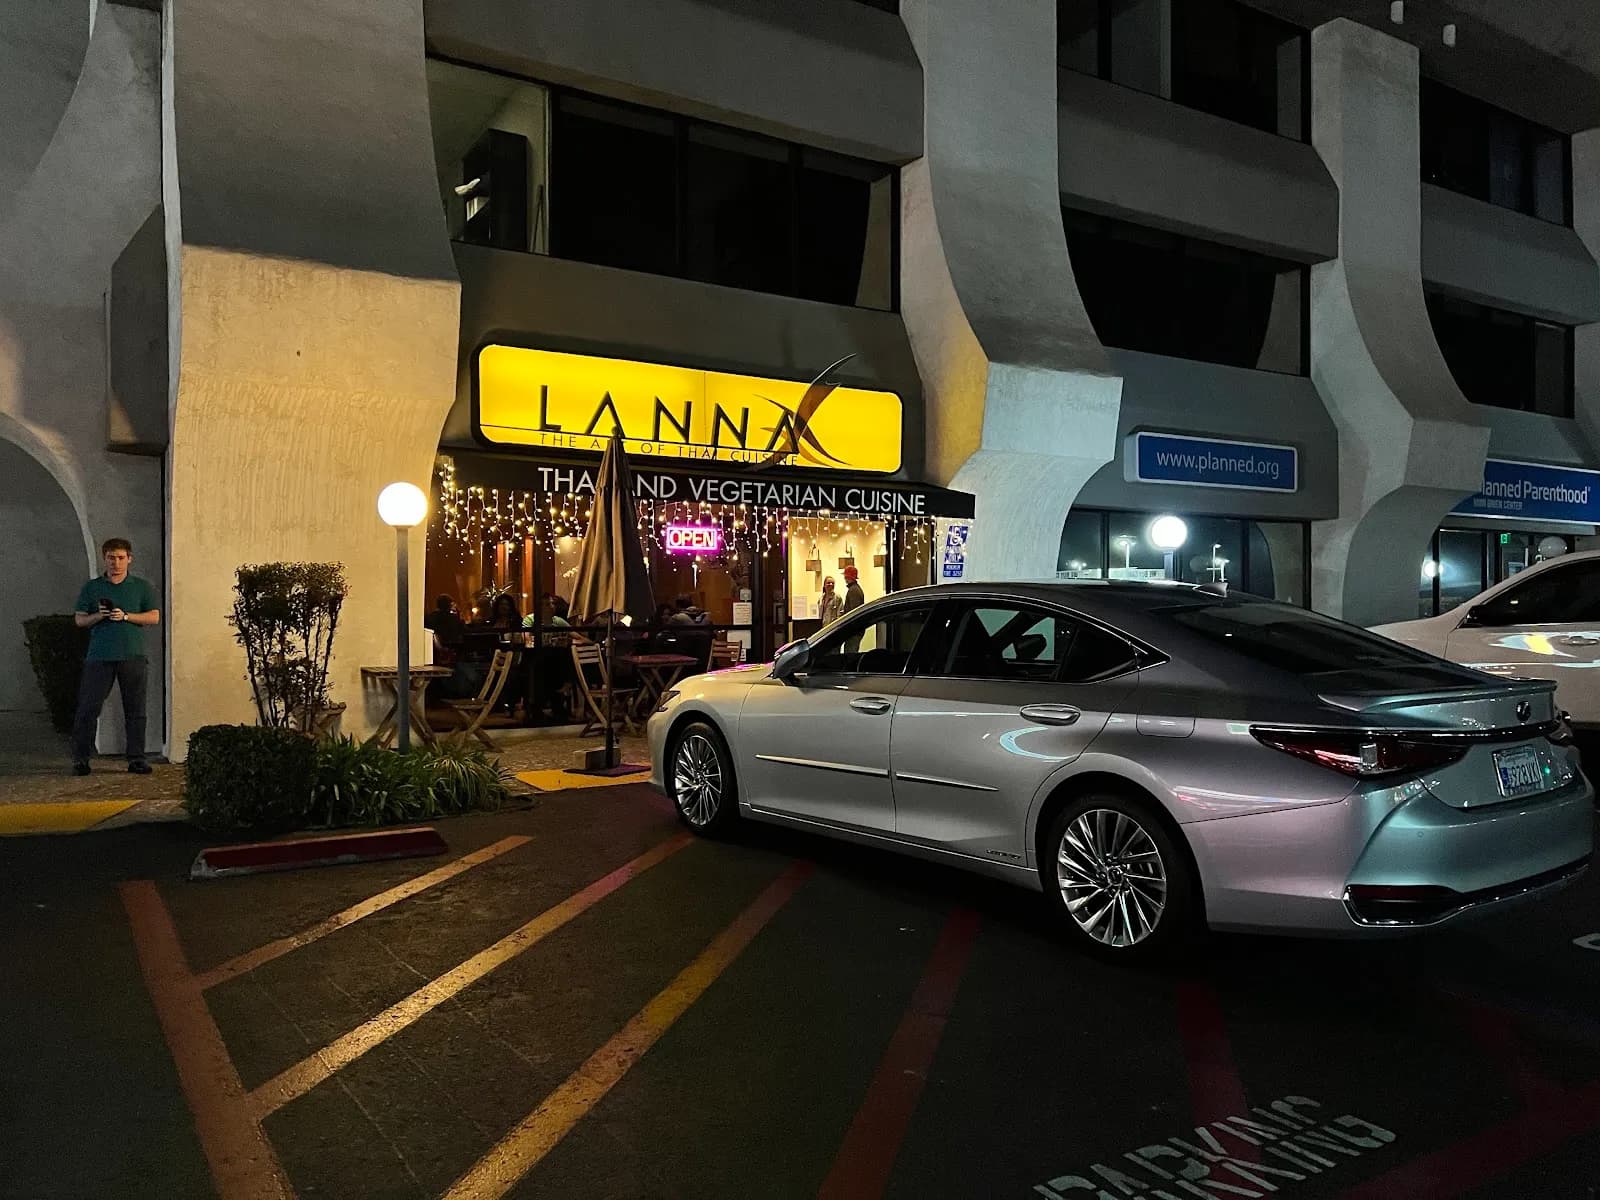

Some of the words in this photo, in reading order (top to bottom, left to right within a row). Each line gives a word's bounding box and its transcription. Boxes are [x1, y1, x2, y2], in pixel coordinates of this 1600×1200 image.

[540, 385, 799, 454] LANNA
[539, 432, 577, 448] THE
[640, 442, 666, 455] OF
[1156, 451, 1279, 480] www.planned.org
[538, 466, 597, 494] THA
[688, 477, 836, 508] VEGETARIAN
[845, 488, 925, 515] CUISINE
[1482, 480, 1521, 498] lanned
[1524, 482, 1588, 504] Parenthood
[669, 529, 715, 548] OPEN
